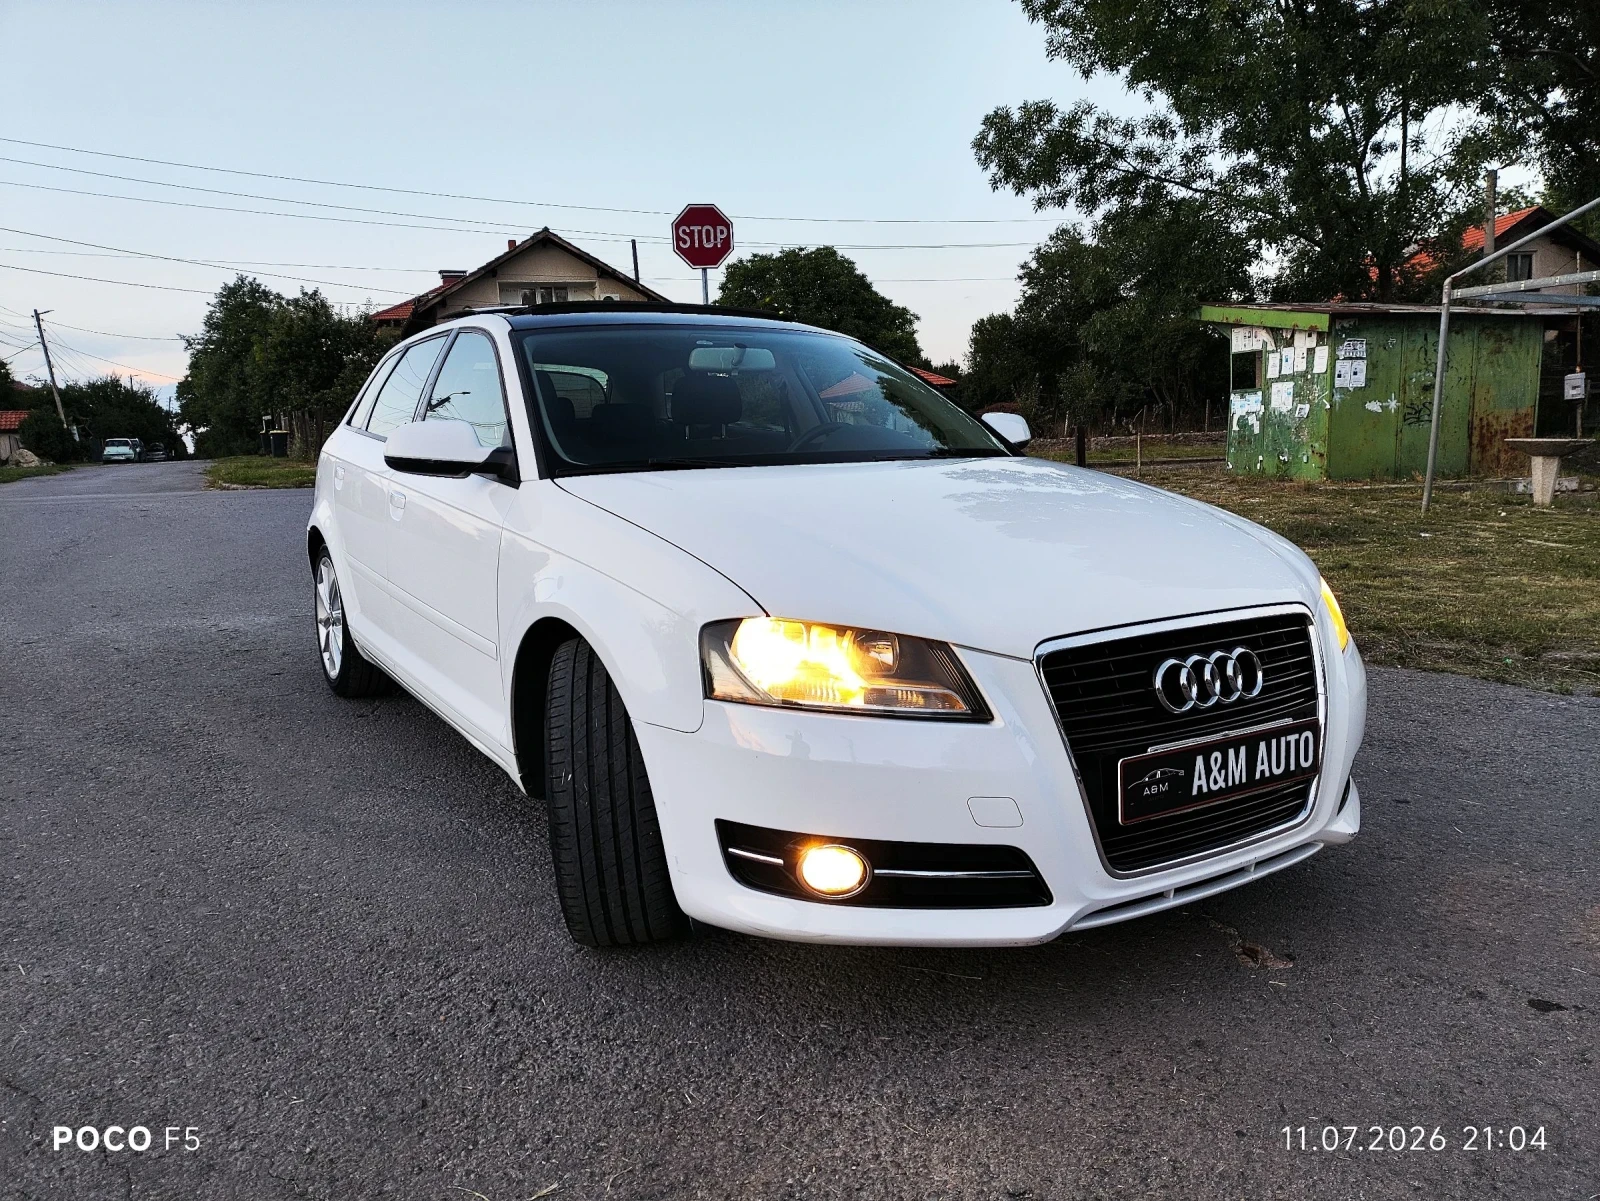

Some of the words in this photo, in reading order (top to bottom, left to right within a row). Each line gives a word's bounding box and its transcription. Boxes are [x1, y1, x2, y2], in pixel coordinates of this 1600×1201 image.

[678, 225, 728, 249] STOP
[1191, 745, 1247, 796] A&M
[1255, 730, 1314, 780] AUTO
[1143, 782, 1169, 796] A&M
